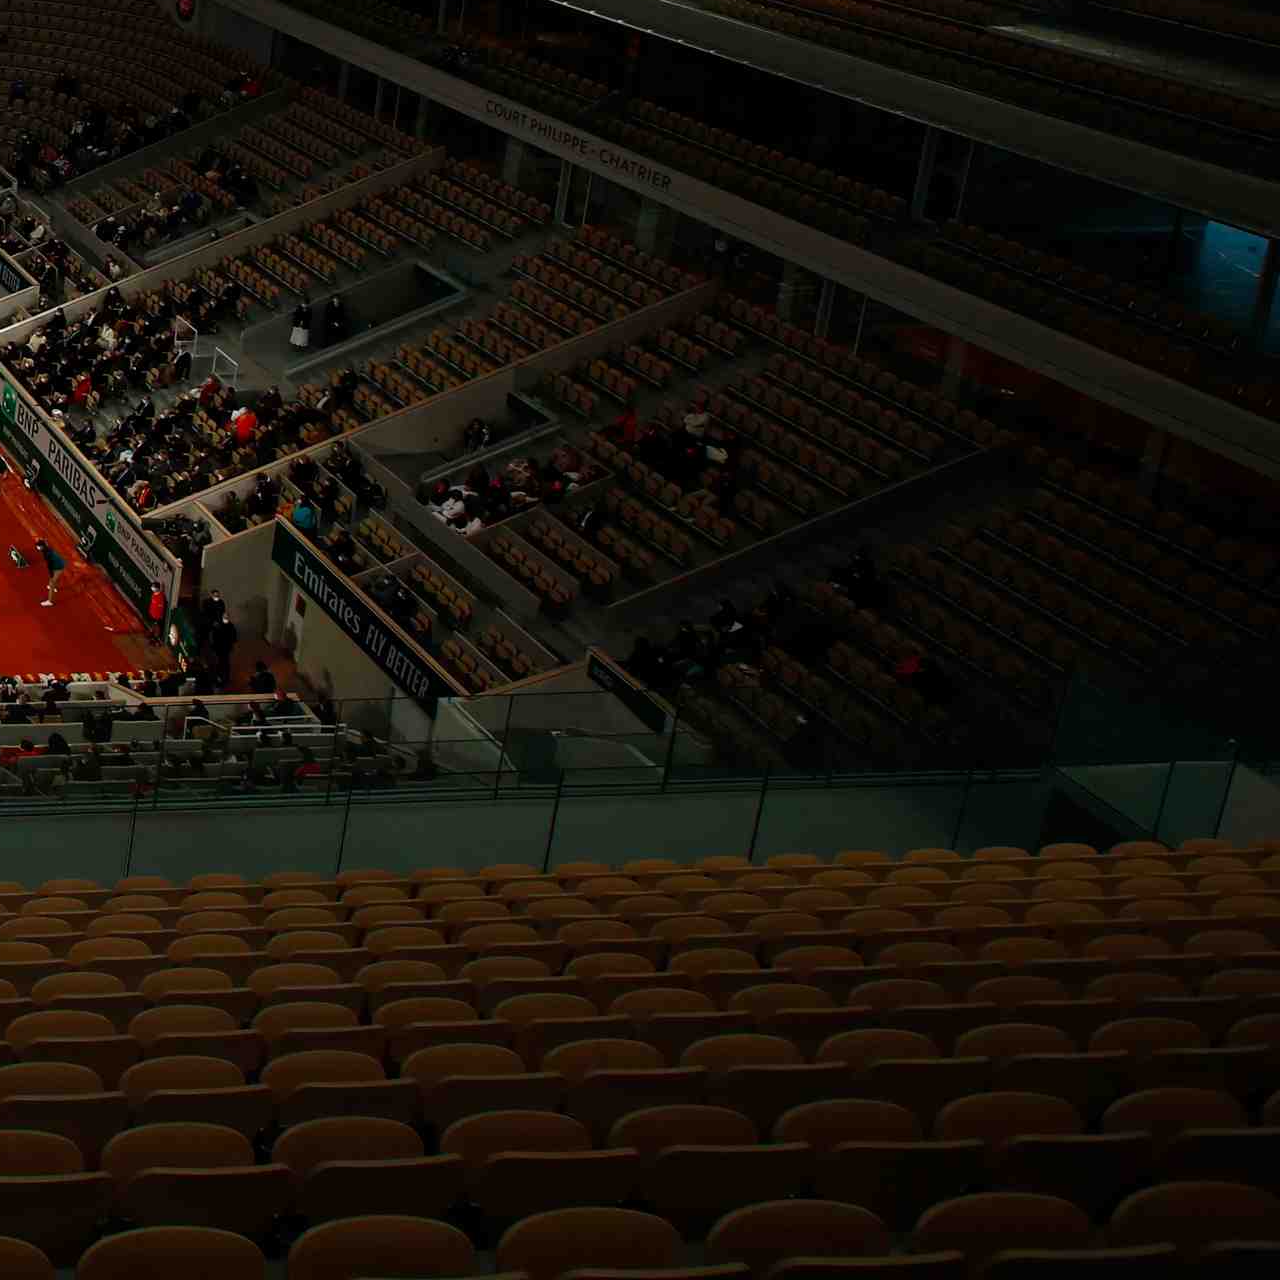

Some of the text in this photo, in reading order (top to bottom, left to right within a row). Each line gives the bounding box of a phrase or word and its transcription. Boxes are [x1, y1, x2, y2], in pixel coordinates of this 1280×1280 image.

[486, 99, 527, 129] COURT
[16, 406, 39, 437] BNP
[48, 439, 96, 509] PARIBAS
[294, 552, 429, 698] Emirates FLY BETTER
